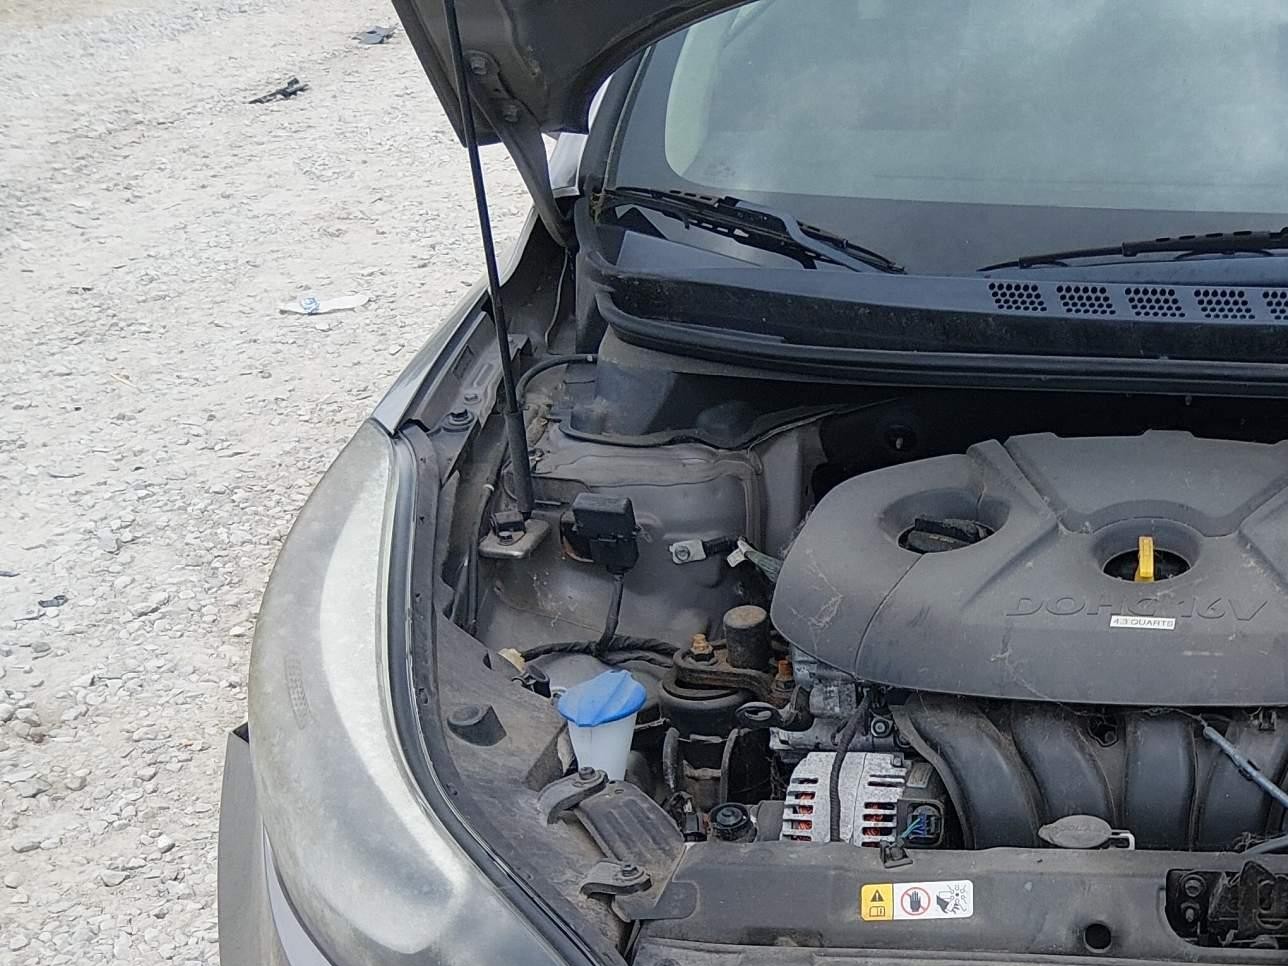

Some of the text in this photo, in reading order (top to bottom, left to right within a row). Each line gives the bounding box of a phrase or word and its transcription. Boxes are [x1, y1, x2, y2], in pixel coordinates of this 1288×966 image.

[1005, 597, 1269, 621] DOHC 16V
[1130, 618, 1174, 628] QUARTS
